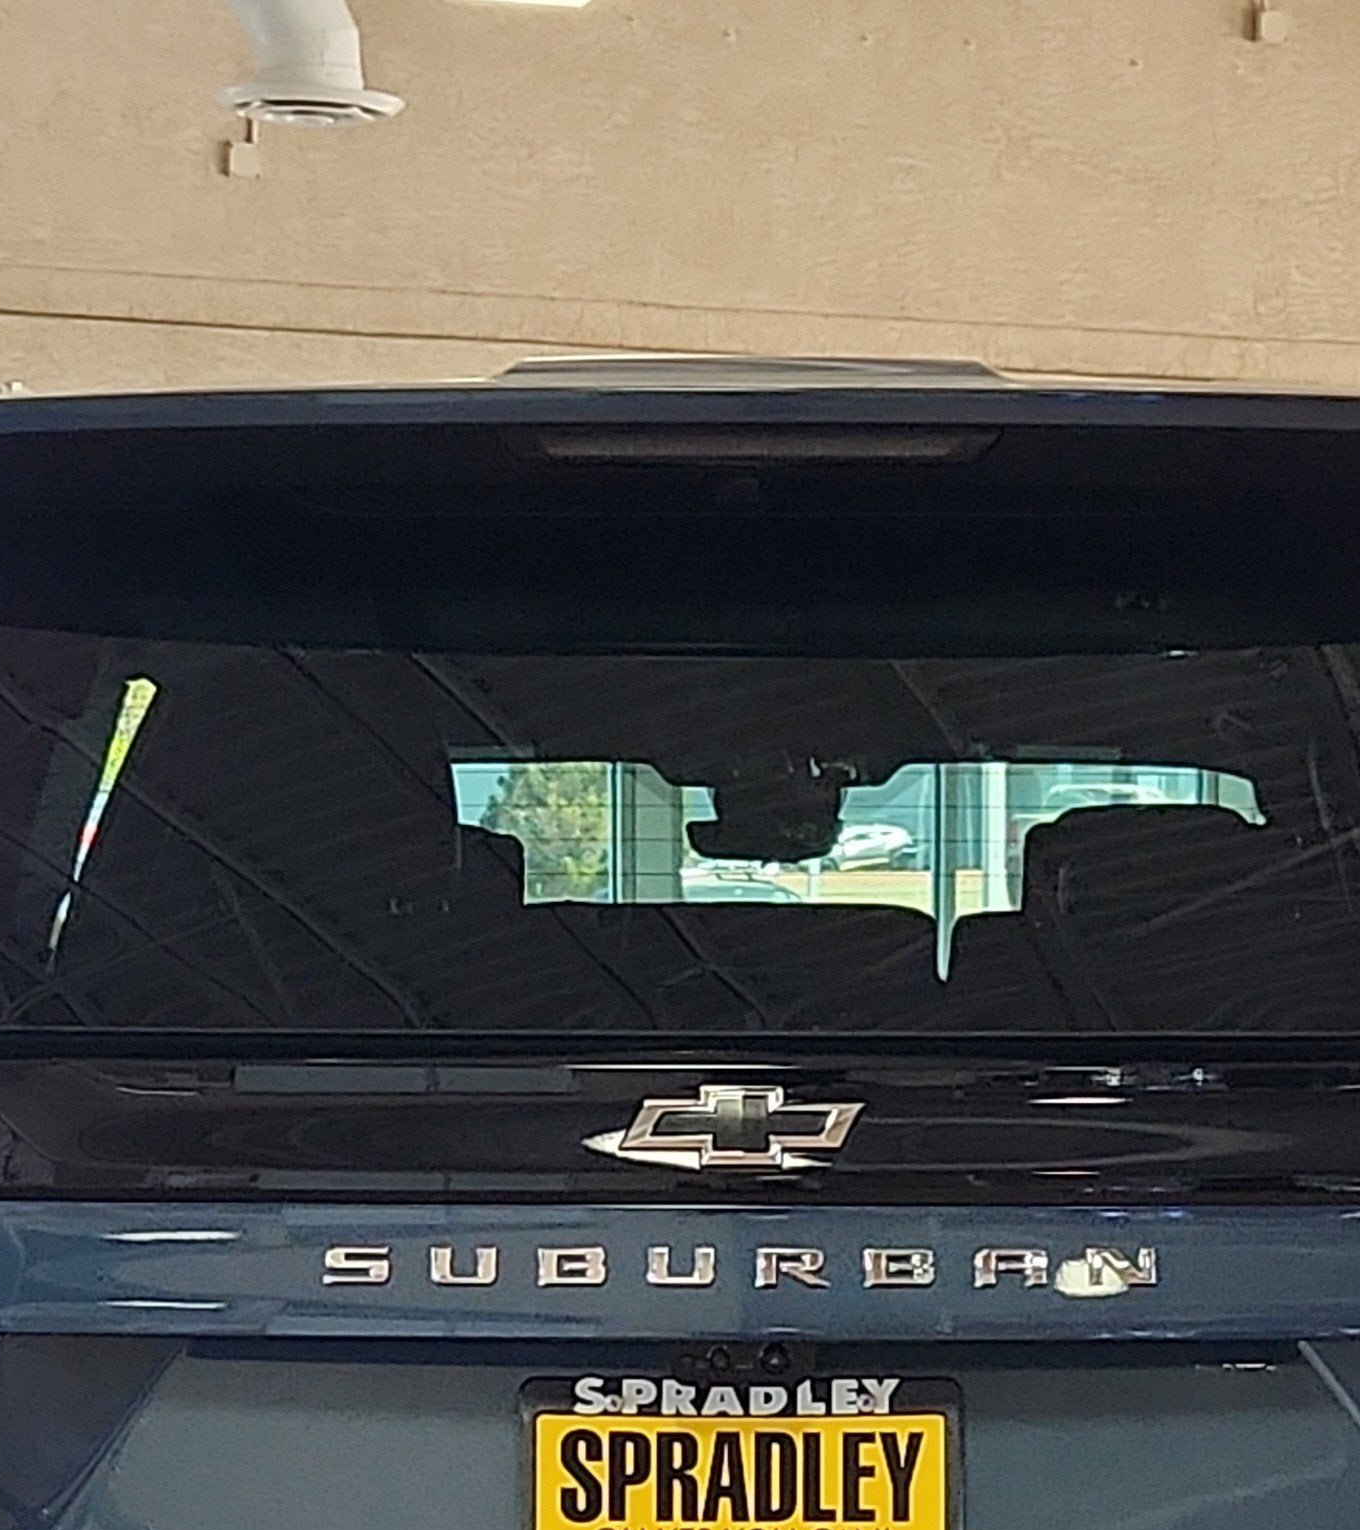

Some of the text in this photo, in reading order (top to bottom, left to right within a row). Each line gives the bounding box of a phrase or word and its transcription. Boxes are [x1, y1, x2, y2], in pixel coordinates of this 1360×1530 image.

[322, 1246, 1158, 1287] SUBURBAN
[573, 1377, 901, 1416] SPRADLEY
[560, 1429, 924, 1523] SPRADLEY
